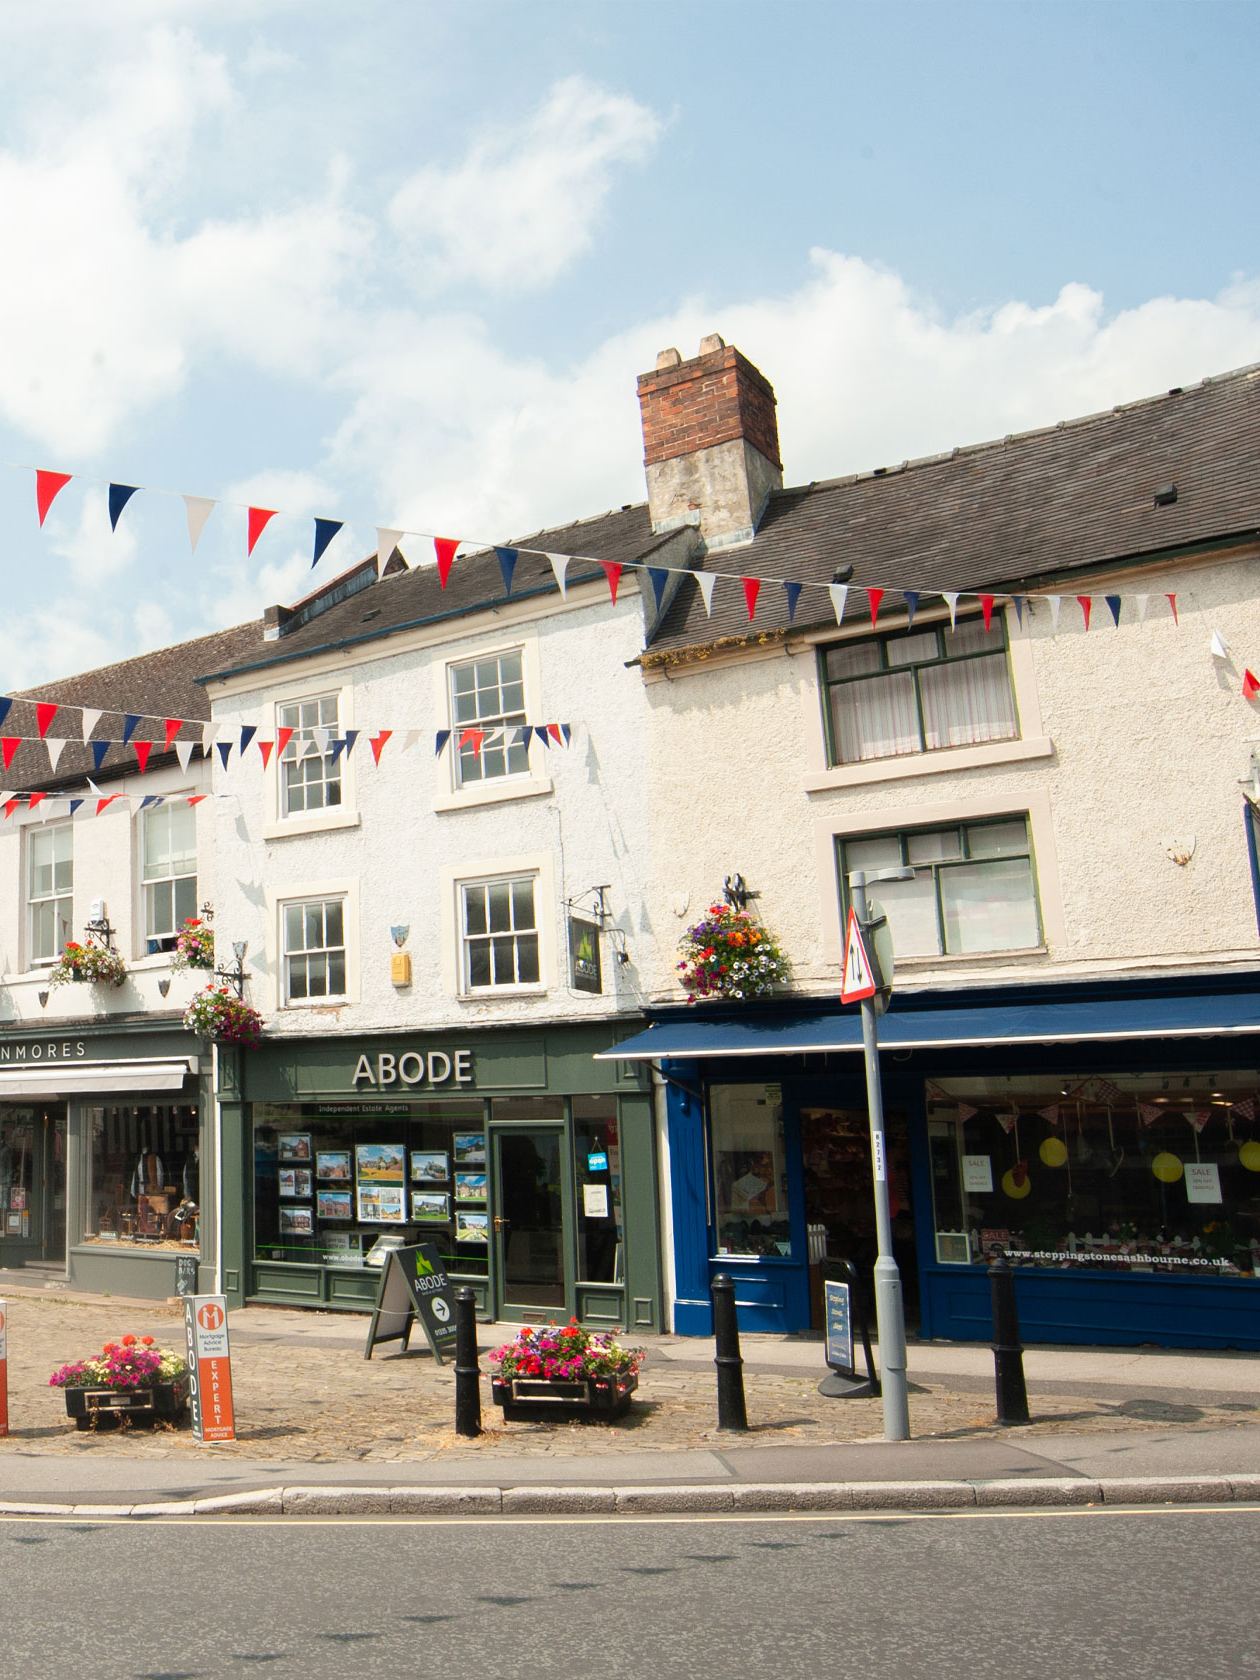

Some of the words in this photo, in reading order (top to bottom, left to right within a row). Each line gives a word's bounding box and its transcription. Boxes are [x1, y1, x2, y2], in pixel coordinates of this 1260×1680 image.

[352, 1050, 472, 1085] ABODE
[319, 1104, 360, 1113] Independent
[361, 1104, 383, 1112] Estate
[385, 1104, 409, 1113] Agents
[1191, 1168, 1211, 1176] SALE
[982, 1231, 1008, 1241] SALE
[1004, 1249, 1230, 1267] www.steppingstonesashbourne.co.uk
[414, 1273, 447, 1292] ABODE
[185, 1303, 198, 1422] ABODE
[211, 1360, 222, 1425] EXPERT
